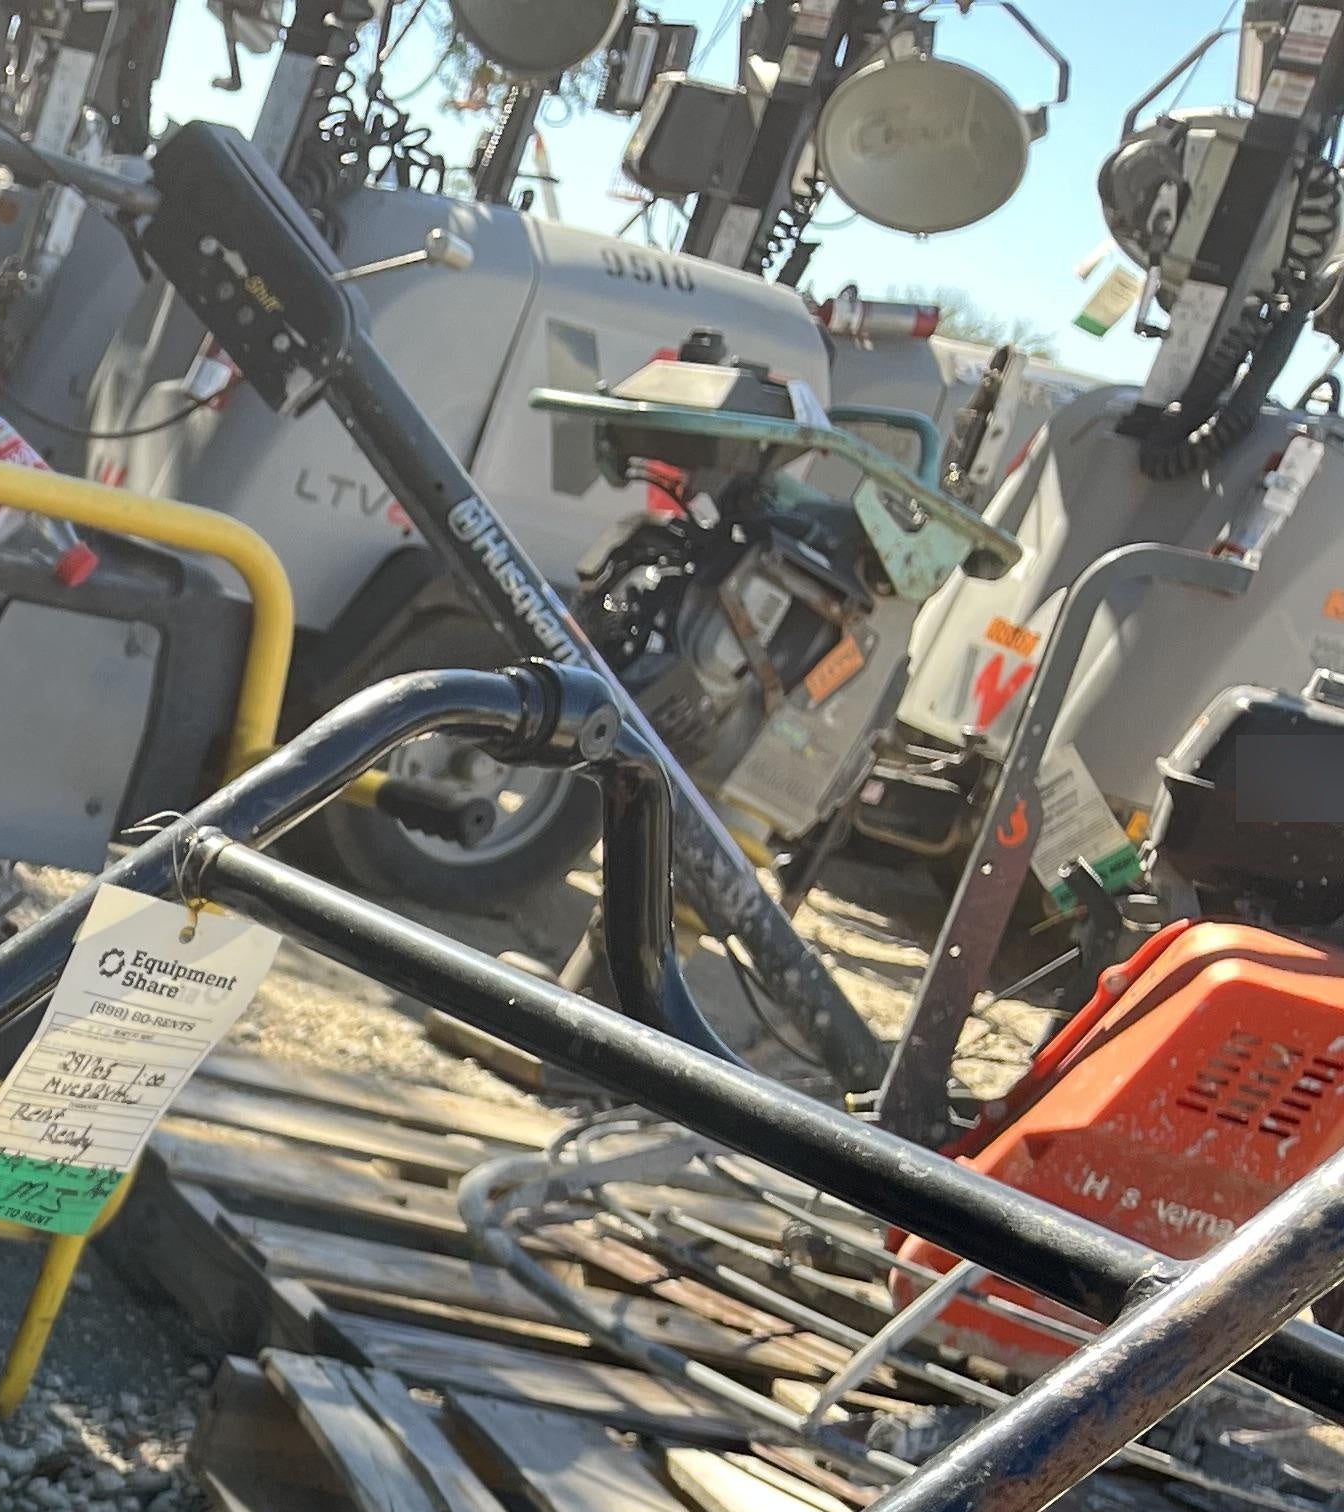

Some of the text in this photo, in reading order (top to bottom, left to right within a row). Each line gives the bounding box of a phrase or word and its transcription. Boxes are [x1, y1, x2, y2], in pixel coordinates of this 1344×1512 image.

[470, 523, 586, 669] Husqvarn
[121, 970, 180, 999] Share
[130, 949, 238, 991] Equipment
